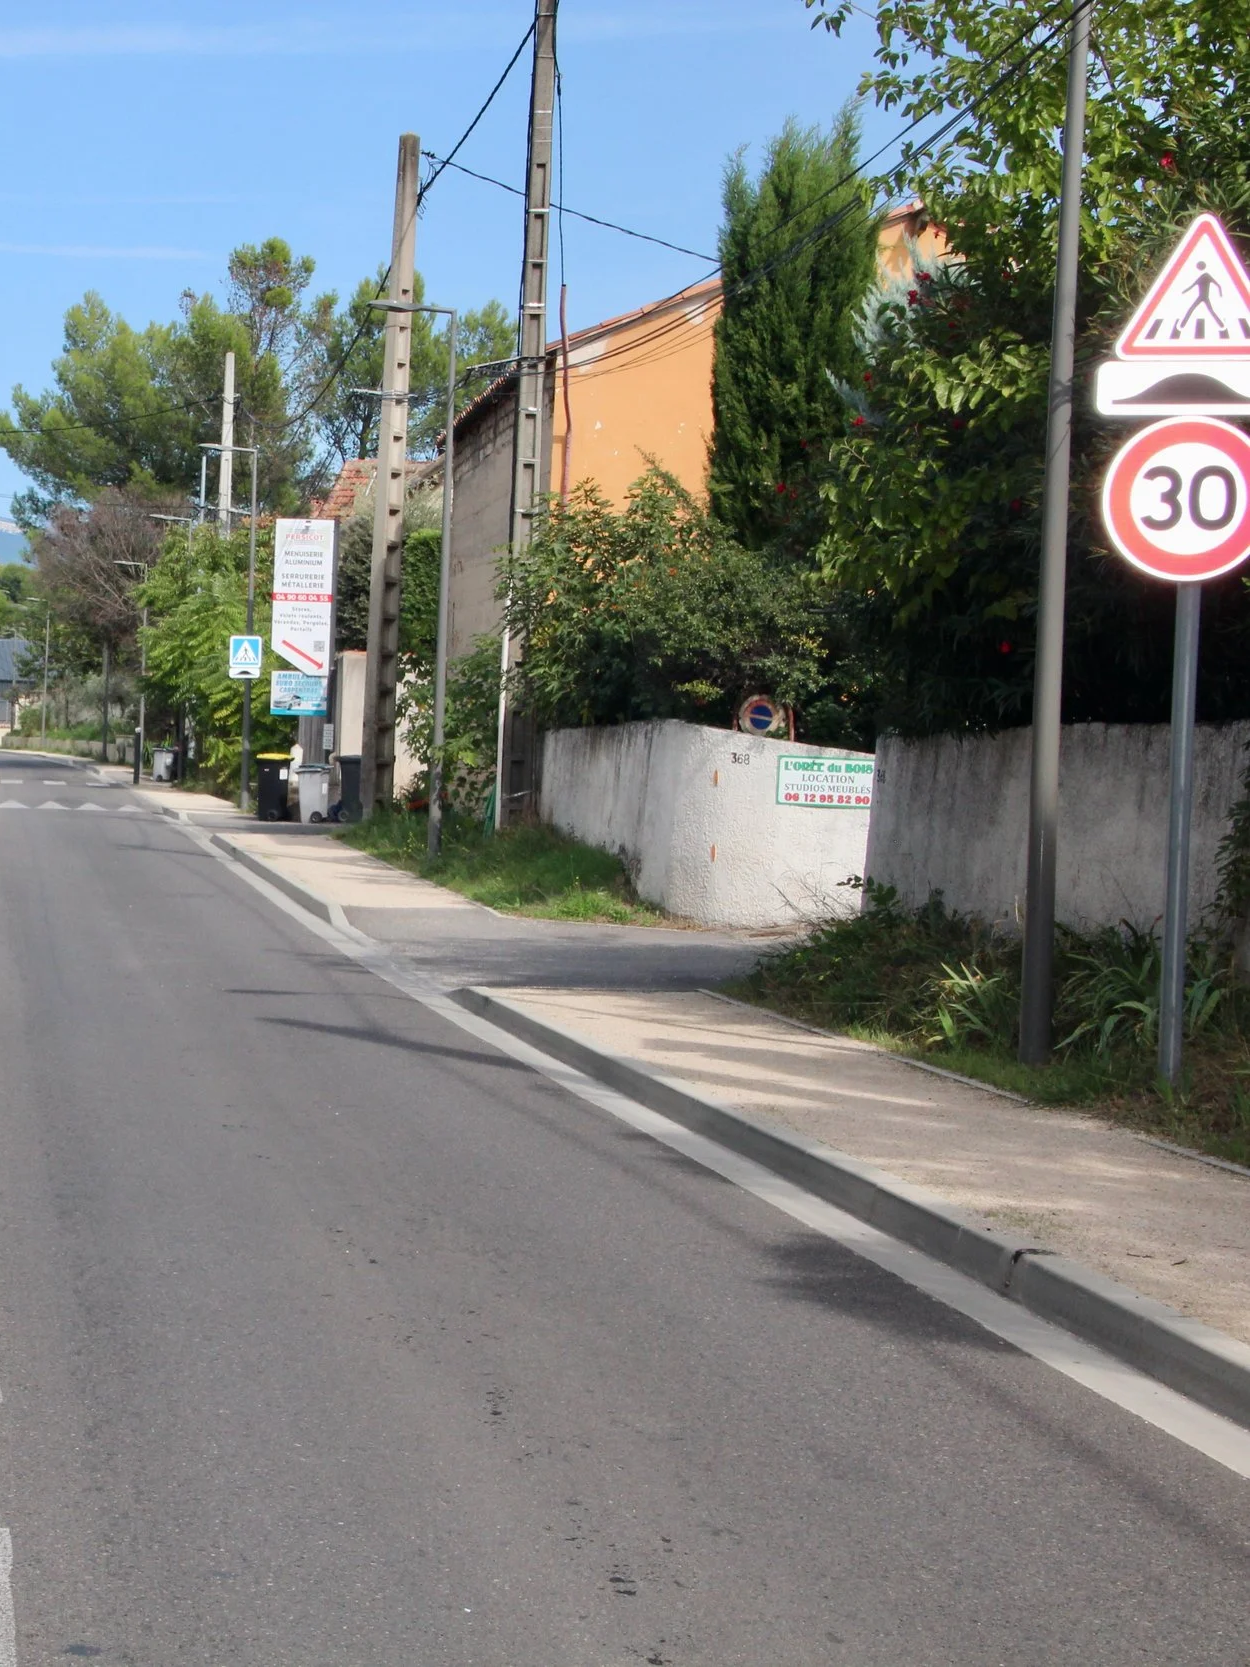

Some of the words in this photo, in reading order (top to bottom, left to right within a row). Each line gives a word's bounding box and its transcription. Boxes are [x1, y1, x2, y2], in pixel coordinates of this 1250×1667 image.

[1140, 465, 1237, 531] 30
[281, 580, 324, 589] MÉTALLERIE
[731, 752, 750, 765] 368
[827, 763, 842, 773] du
[845, 764, 874, 774] BOIS
[802, 774, 855, 784] LOCATION
[784, 783, 825, 792] STUDIOS
[827, 783, 871, 794] MEUBLÉS
[803, 793, 816, 802] 12
